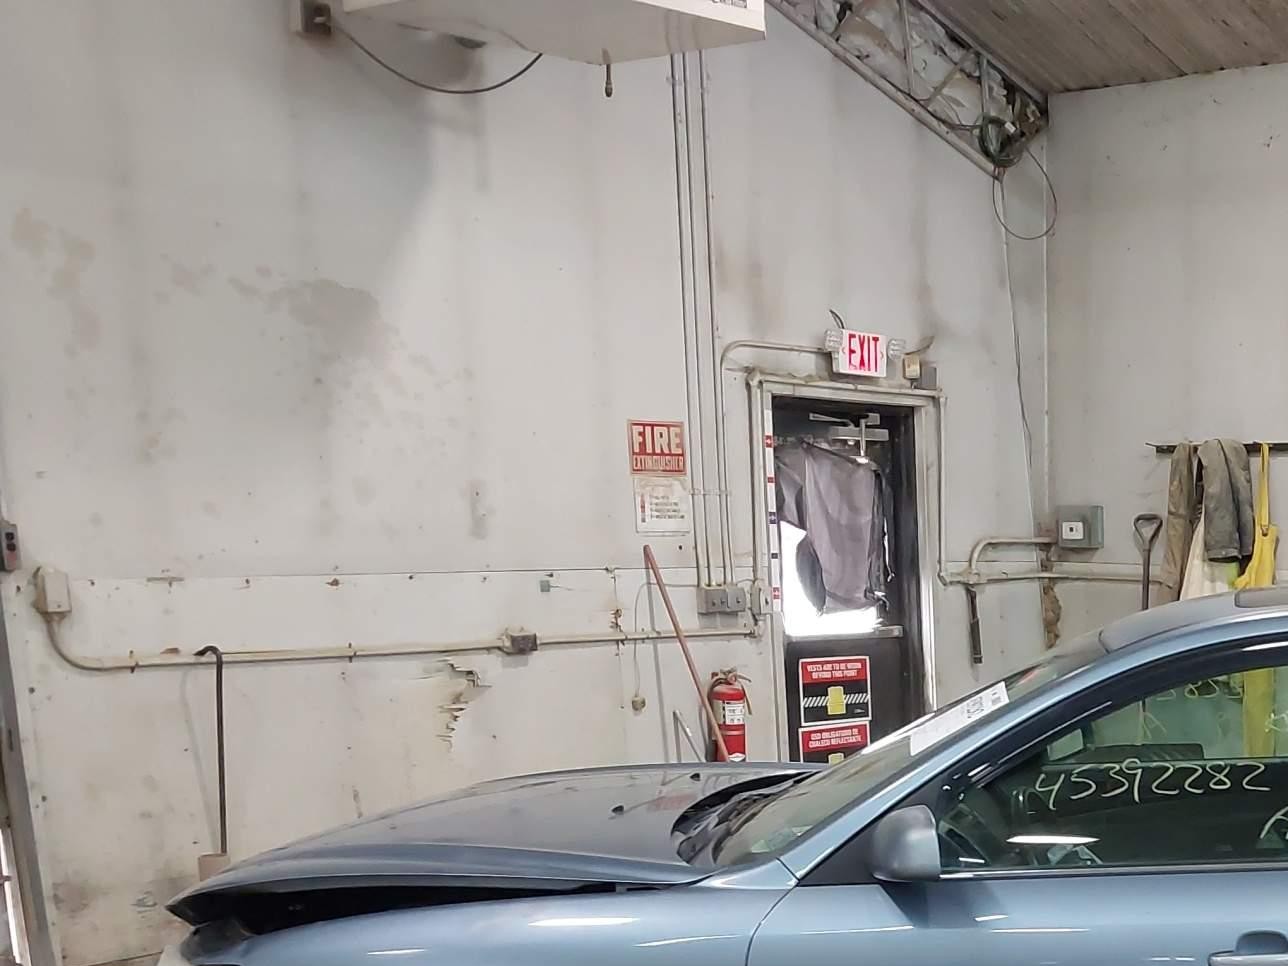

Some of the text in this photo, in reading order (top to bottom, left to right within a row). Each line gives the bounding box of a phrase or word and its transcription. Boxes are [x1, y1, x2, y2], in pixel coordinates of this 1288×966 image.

[848, 333, 880, 373] EXIT
[631, 425, 683, 454] FIRE
[1035, 758, 1271, 811] 45392282
